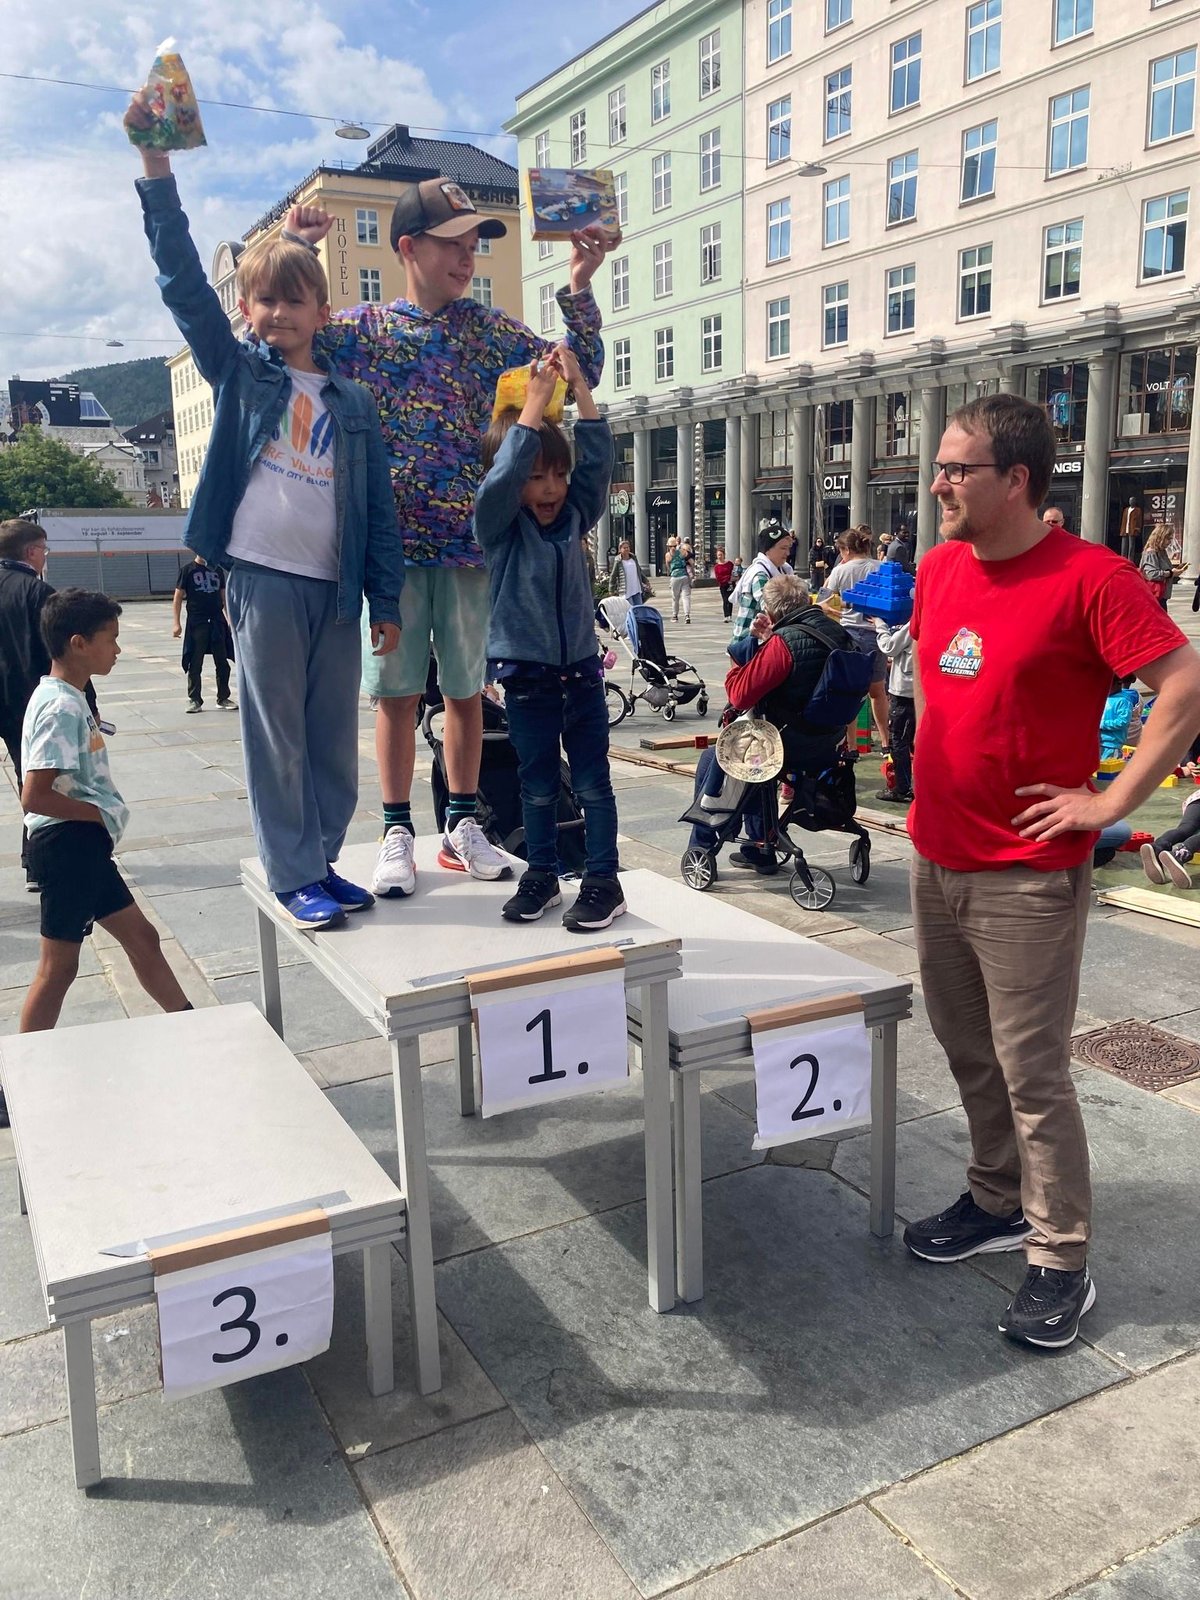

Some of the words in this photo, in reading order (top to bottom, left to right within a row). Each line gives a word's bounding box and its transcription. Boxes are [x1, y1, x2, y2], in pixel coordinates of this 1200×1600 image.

[336, 218, 349, 296] HOTEL
[1146, 381, 1171, 392] VOLT
[262, 443, 285, 460] URF
[291, 457, 334, 478] VILLAG
[1053, 462, 1082, 474] NGS
[287, 471, 303, 481] CITY
[823, 475, 849, 490] OLT
[1151, 495, 1161, 509] 3
[1166, 494, 1176, 508] 2
[939, 654, 981, 670] BERGEN
[526, 1009, 588, 1085] 1.
[790, 1054, 842, 1122] 2.
[212, 1286, 288, 1363] 3.
